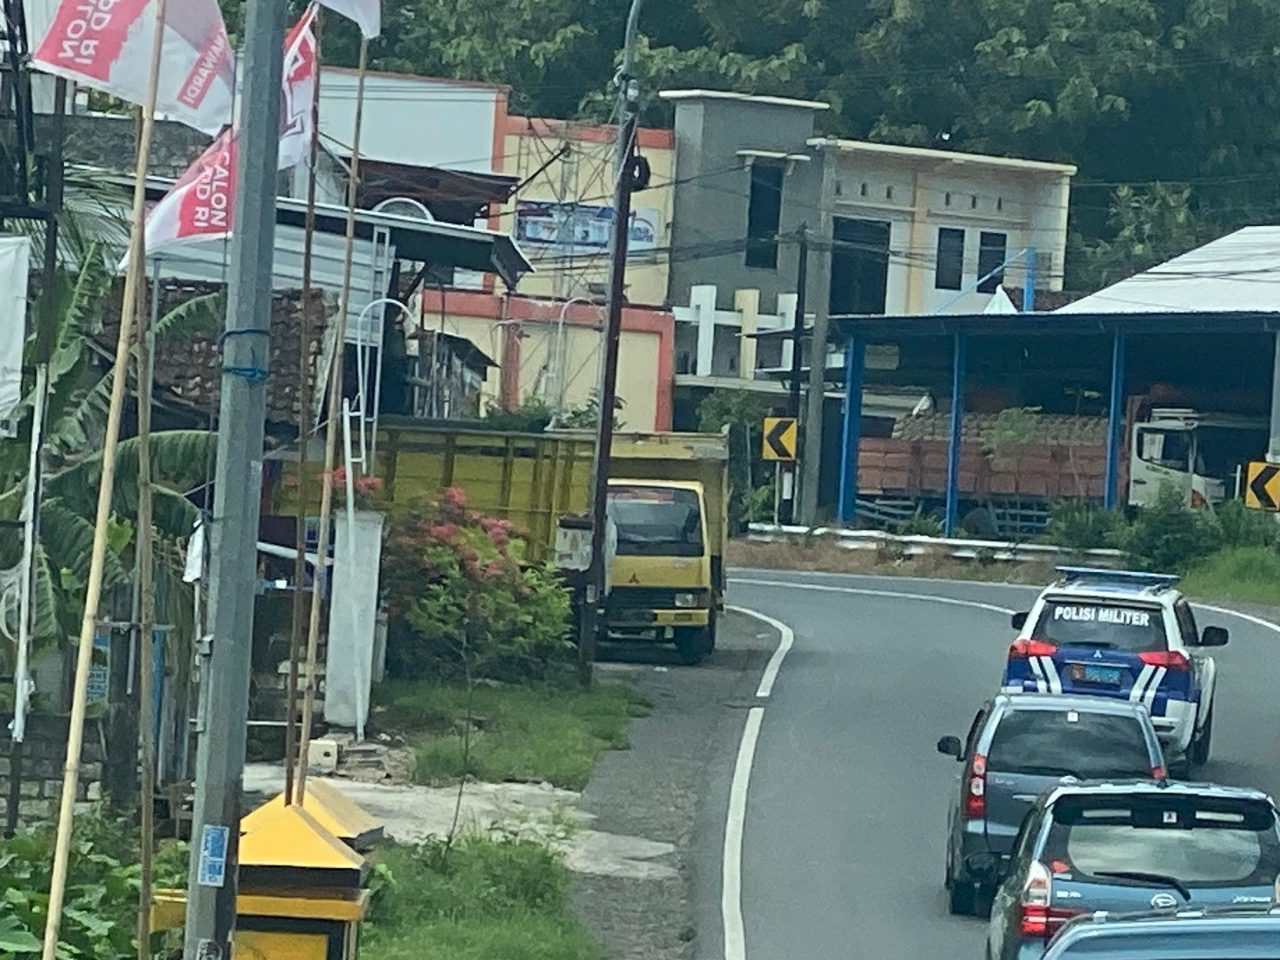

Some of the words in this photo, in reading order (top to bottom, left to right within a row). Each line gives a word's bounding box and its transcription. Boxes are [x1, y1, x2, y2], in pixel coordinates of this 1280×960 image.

[192, 206, 210, 228] RI
[1054, 606, 1096, 620] POLISI
[1098, 609, 1150, 626] MILITER
